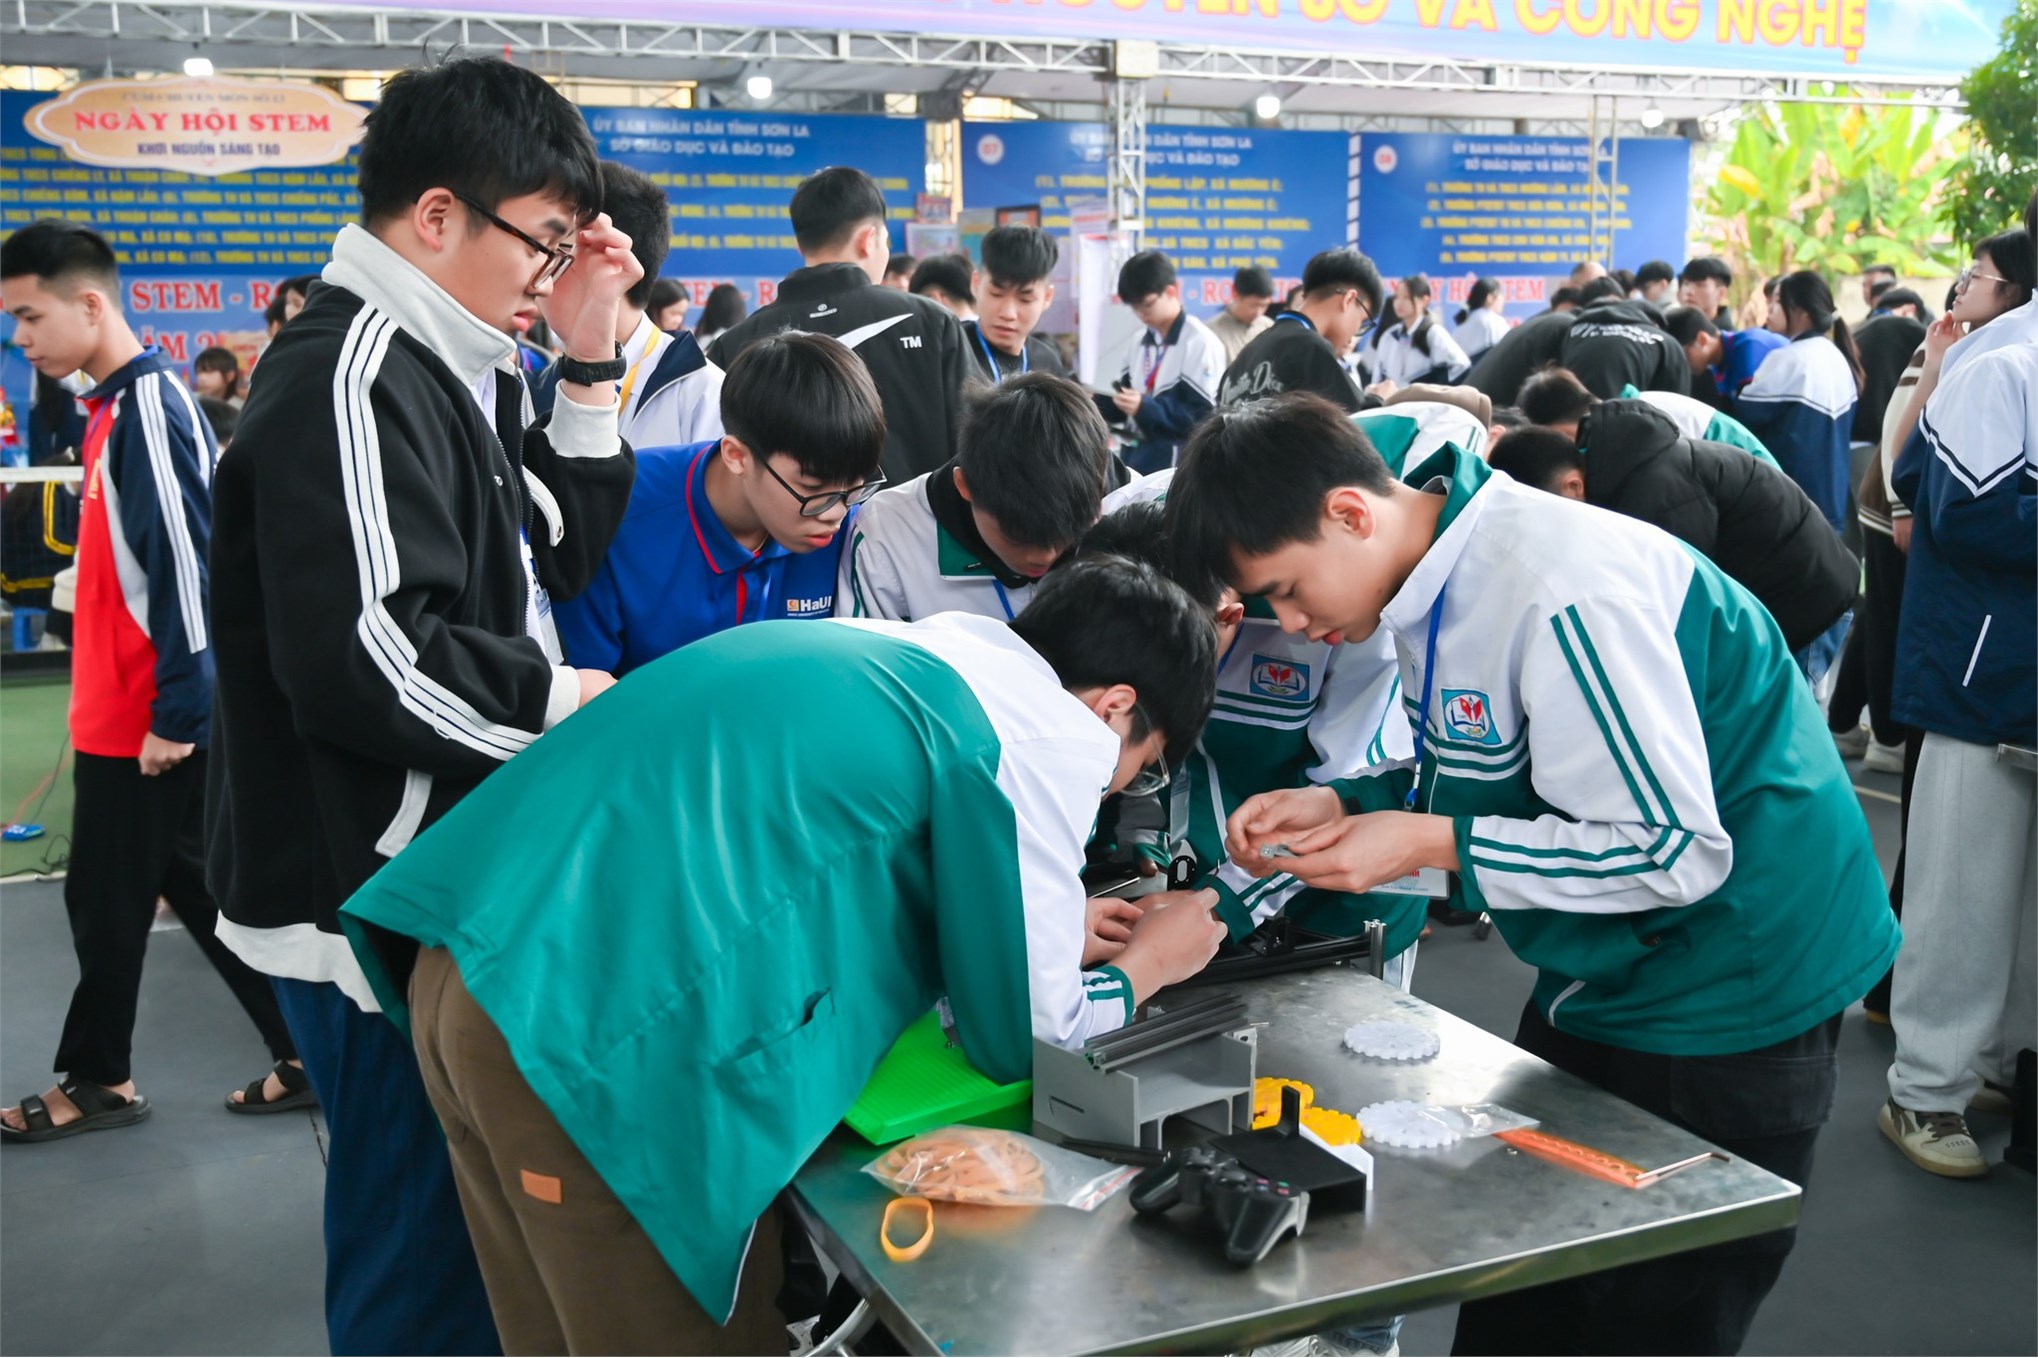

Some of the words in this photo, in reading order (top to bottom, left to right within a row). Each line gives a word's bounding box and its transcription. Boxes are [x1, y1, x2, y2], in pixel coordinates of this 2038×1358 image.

[74, 106, 170, 132] NGÀY
[181, 107, 238, 136] HỘI
[248, 114, 331, 132] STEM
[794, 125, 810, 138] LA
[131, 281, 221, 310] STEM
[900, 336, 922, 349] TM
[800, 595, 832, 612] HaUI
